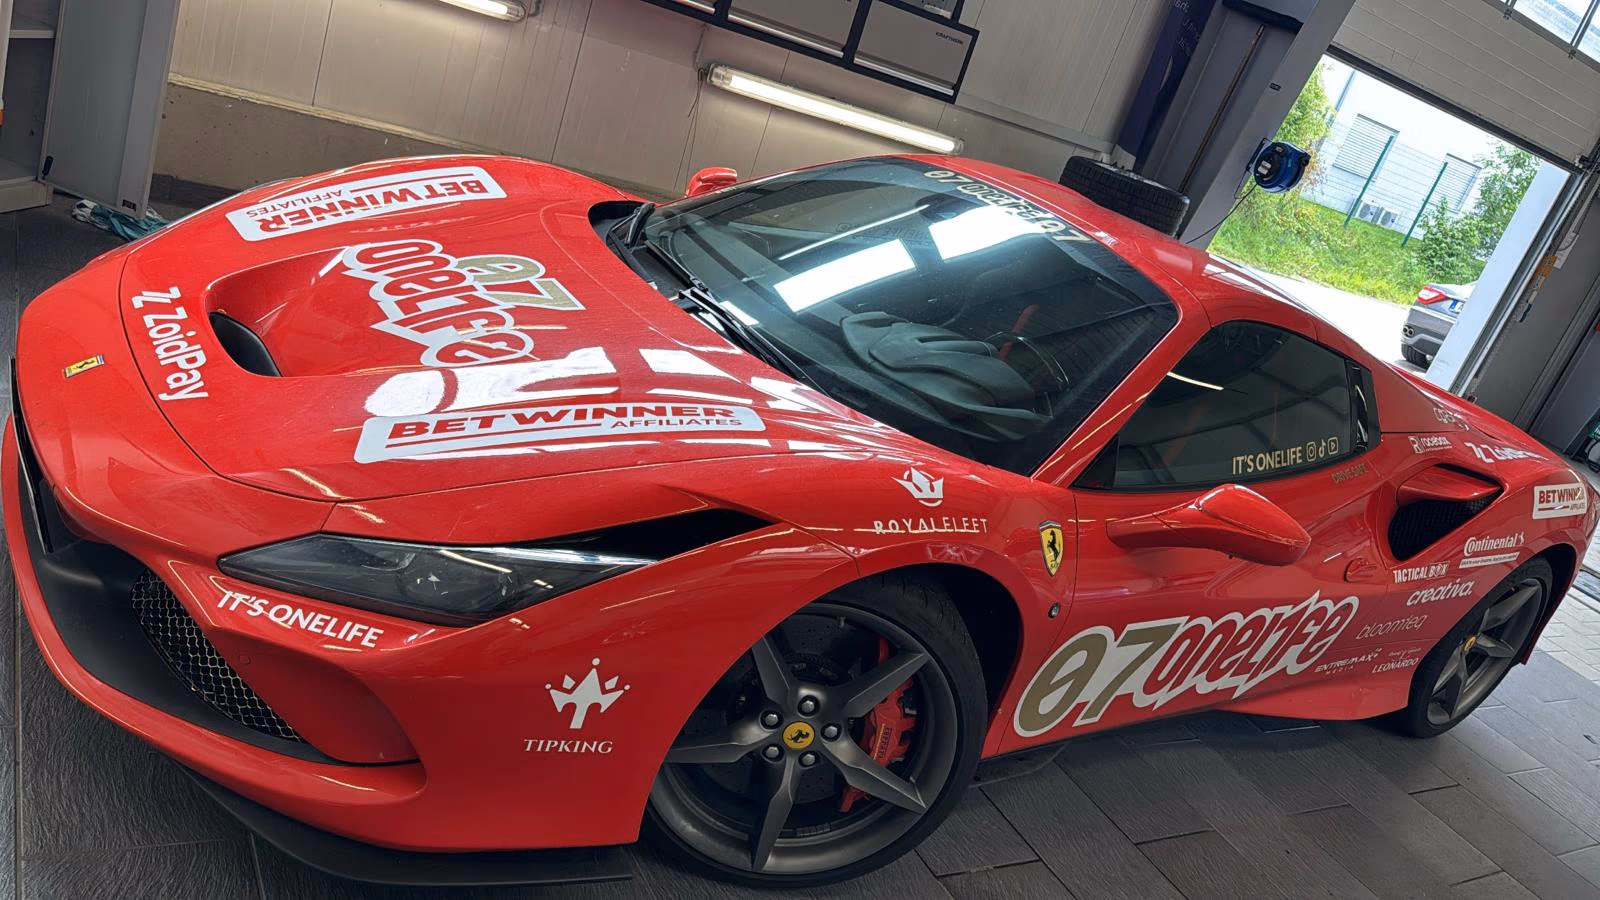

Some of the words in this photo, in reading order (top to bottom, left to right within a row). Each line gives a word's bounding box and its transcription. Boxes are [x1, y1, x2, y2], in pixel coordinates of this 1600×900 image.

[245, 188, 343, 218] AFFILIATES
[256, 178, 490, 234] BETWINNER
[387, 404, 736, 440] BETWINNER
[610, 417, 743, 429] AFFILIATES
[1232, 454, 1254, 475] IT'S
[1255, 446, 1302, 472] ONELIFE
[1538, 486, 1585, 505] BETWINN
[1463, 533, 1517, 557] Continental
[1392, 567, 1428, 583] TACTICAL
[217, 590, 269, 617] IT'S
[268, 604, 385, 649] ONELIFE
[1371, 656, 1420, 674] LEONARDO
[523, 739, 614, 754] TIPKING
